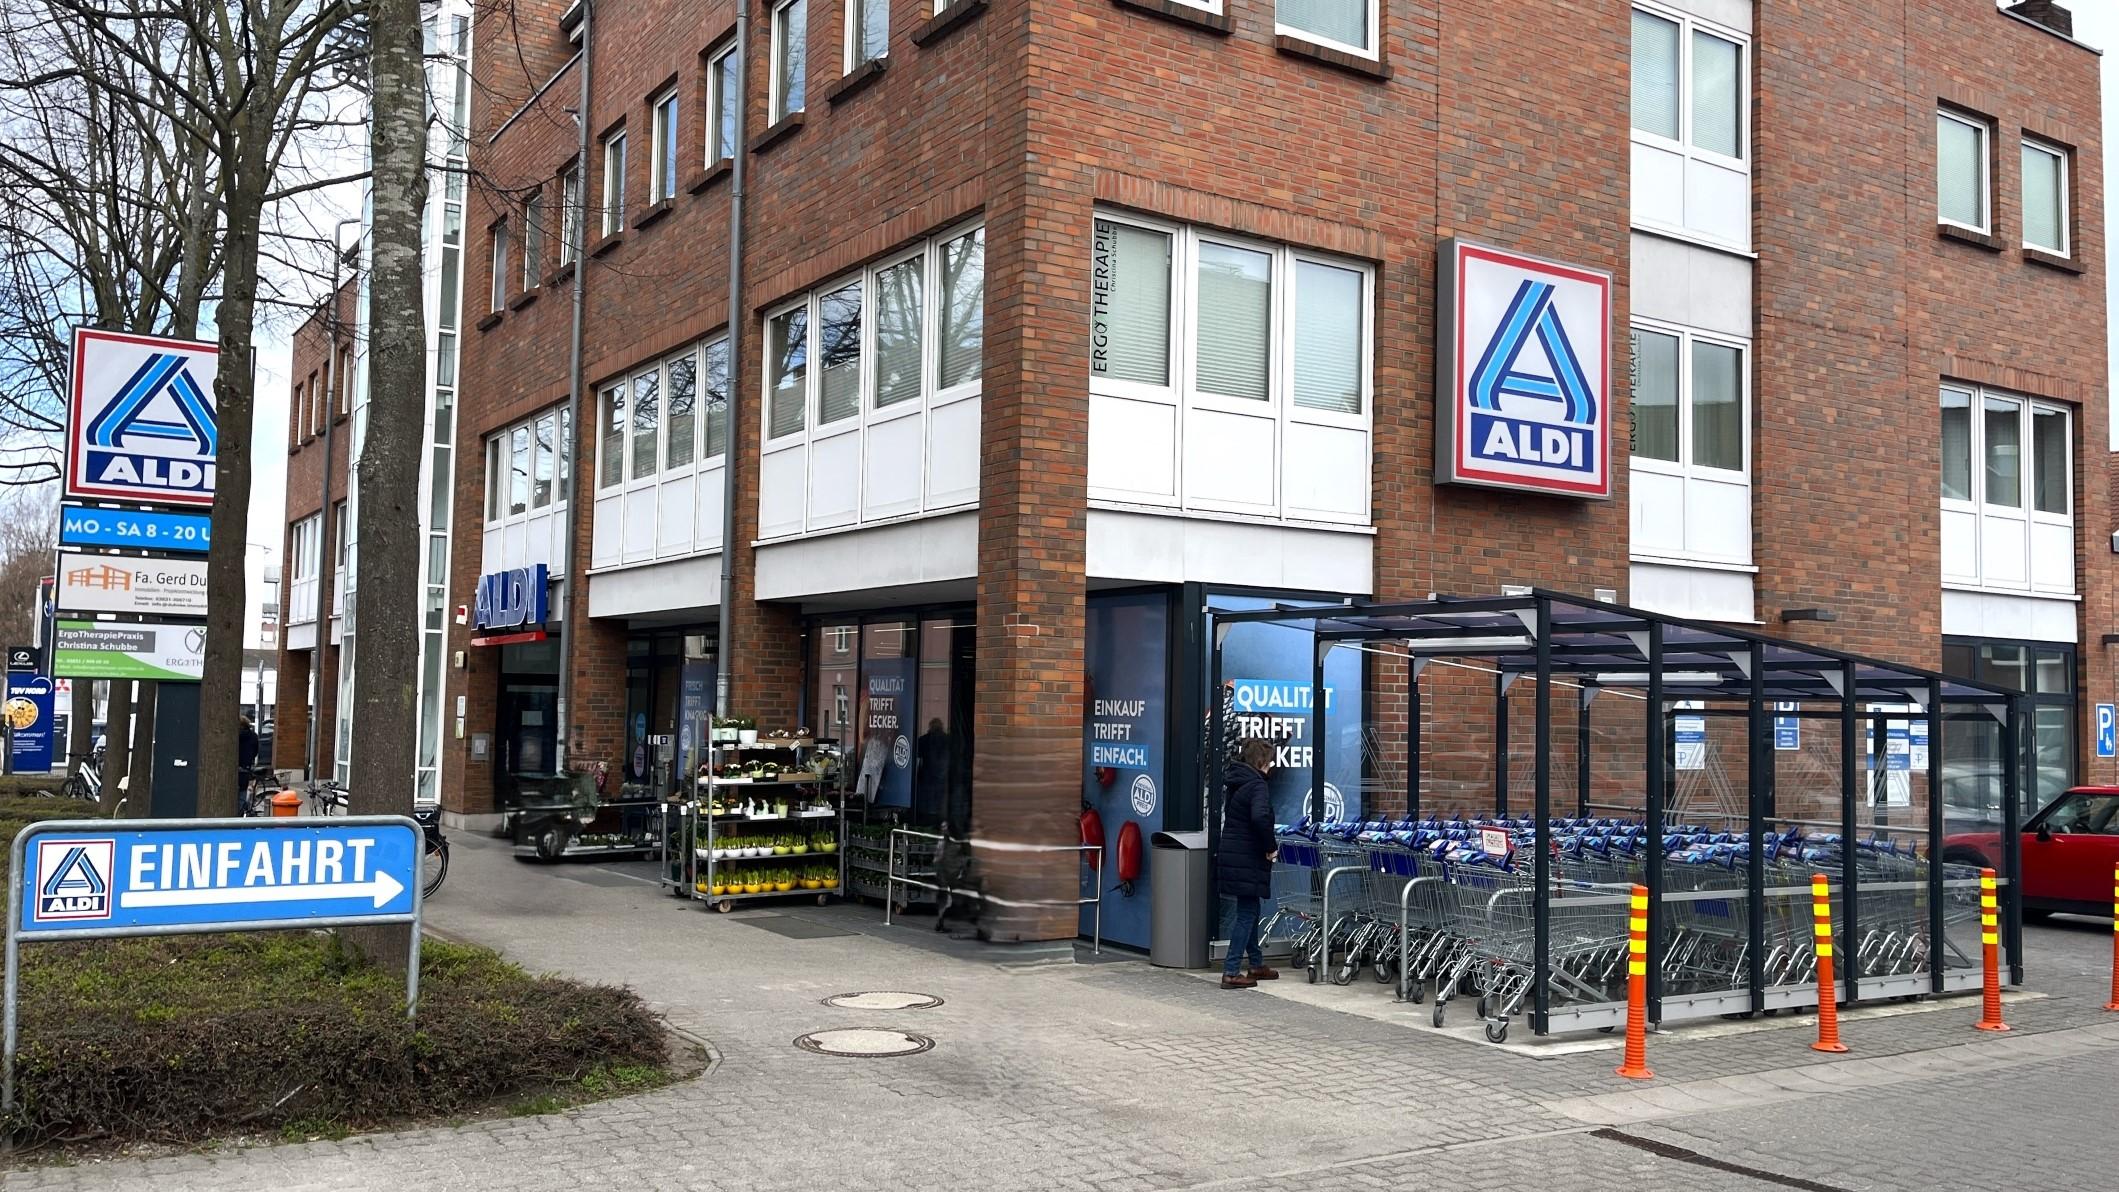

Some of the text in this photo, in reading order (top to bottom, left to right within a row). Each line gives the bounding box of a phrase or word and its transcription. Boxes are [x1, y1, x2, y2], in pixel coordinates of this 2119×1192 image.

[1482, 421, 1583, 468] ALDI
[98, 455, 216, 490] ALDI
[64, 517, 100, 534] MO
[116, 521, 142, 538] SA
[146, 523, 157, 538] 8
[173, 525, 196, 541] 20
[201, 526, 210, 542] U
[135, 571, 207, 588] Fa. Gerd Du
[472, 564, 547, 631] ALDI
[57, 629, 144, 641] ErgoTherapiePraxis
[57, 640, 138, 651] Christina Schubbe
[869, 676, 905, 694] QUALITÄT
[869, 697, 894, 711] TRIFFT
[1094, 699, 1146, 718] EINKAUF
[869, 714, 899, 729] LECKER.
[1237, 716, 1305, 739] TRIFFT
[2098, 707, 2112, 741] P
[1093, 723, 1132, 741] TRIFFT
[1093, 746, 1147, 767] EINFACH.
[1134, 787, 1153, 806] ALDI
[129, 838, 376, 891] EINFAHRT
[47, 896, 99, 912] ALDI
